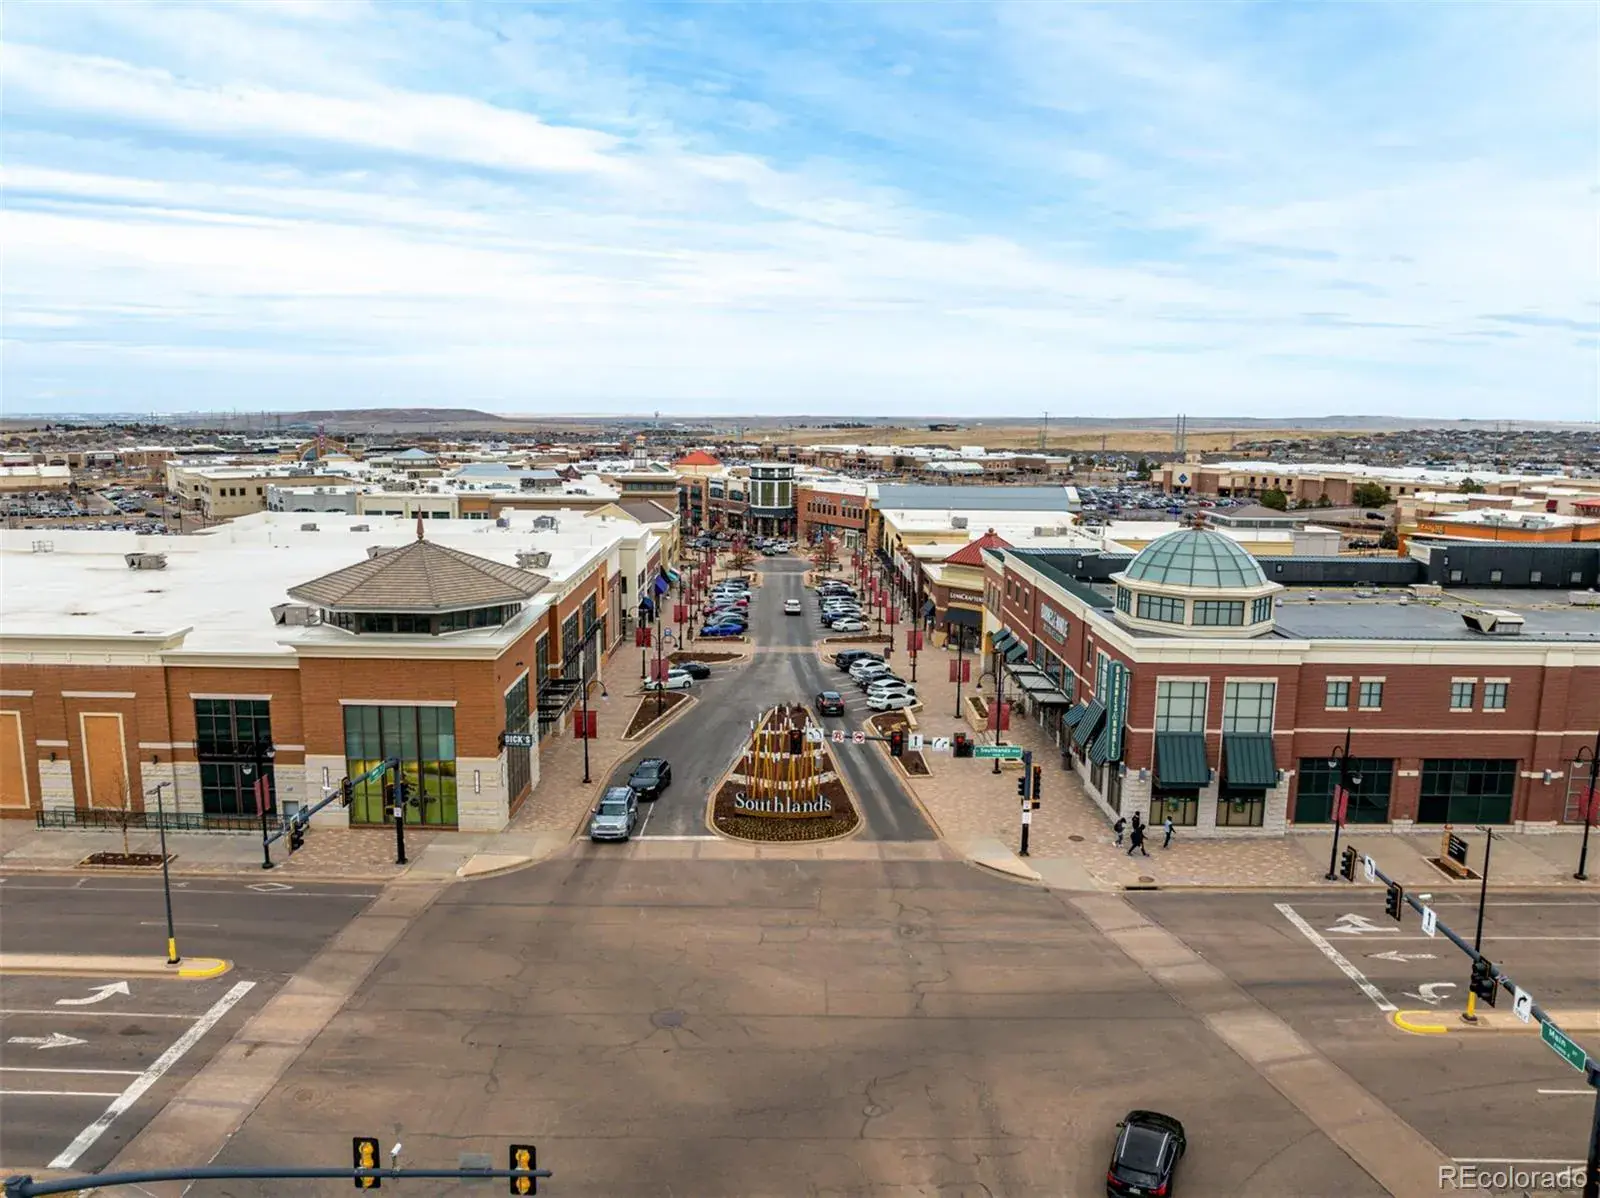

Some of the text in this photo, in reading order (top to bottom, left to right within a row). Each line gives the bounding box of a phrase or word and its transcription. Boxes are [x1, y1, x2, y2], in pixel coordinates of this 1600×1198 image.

[504, 735, 531, 744] DICK'S
[734, 791, 832, 813] Southlands
[1548, 1028, 1567, 1048] Main
